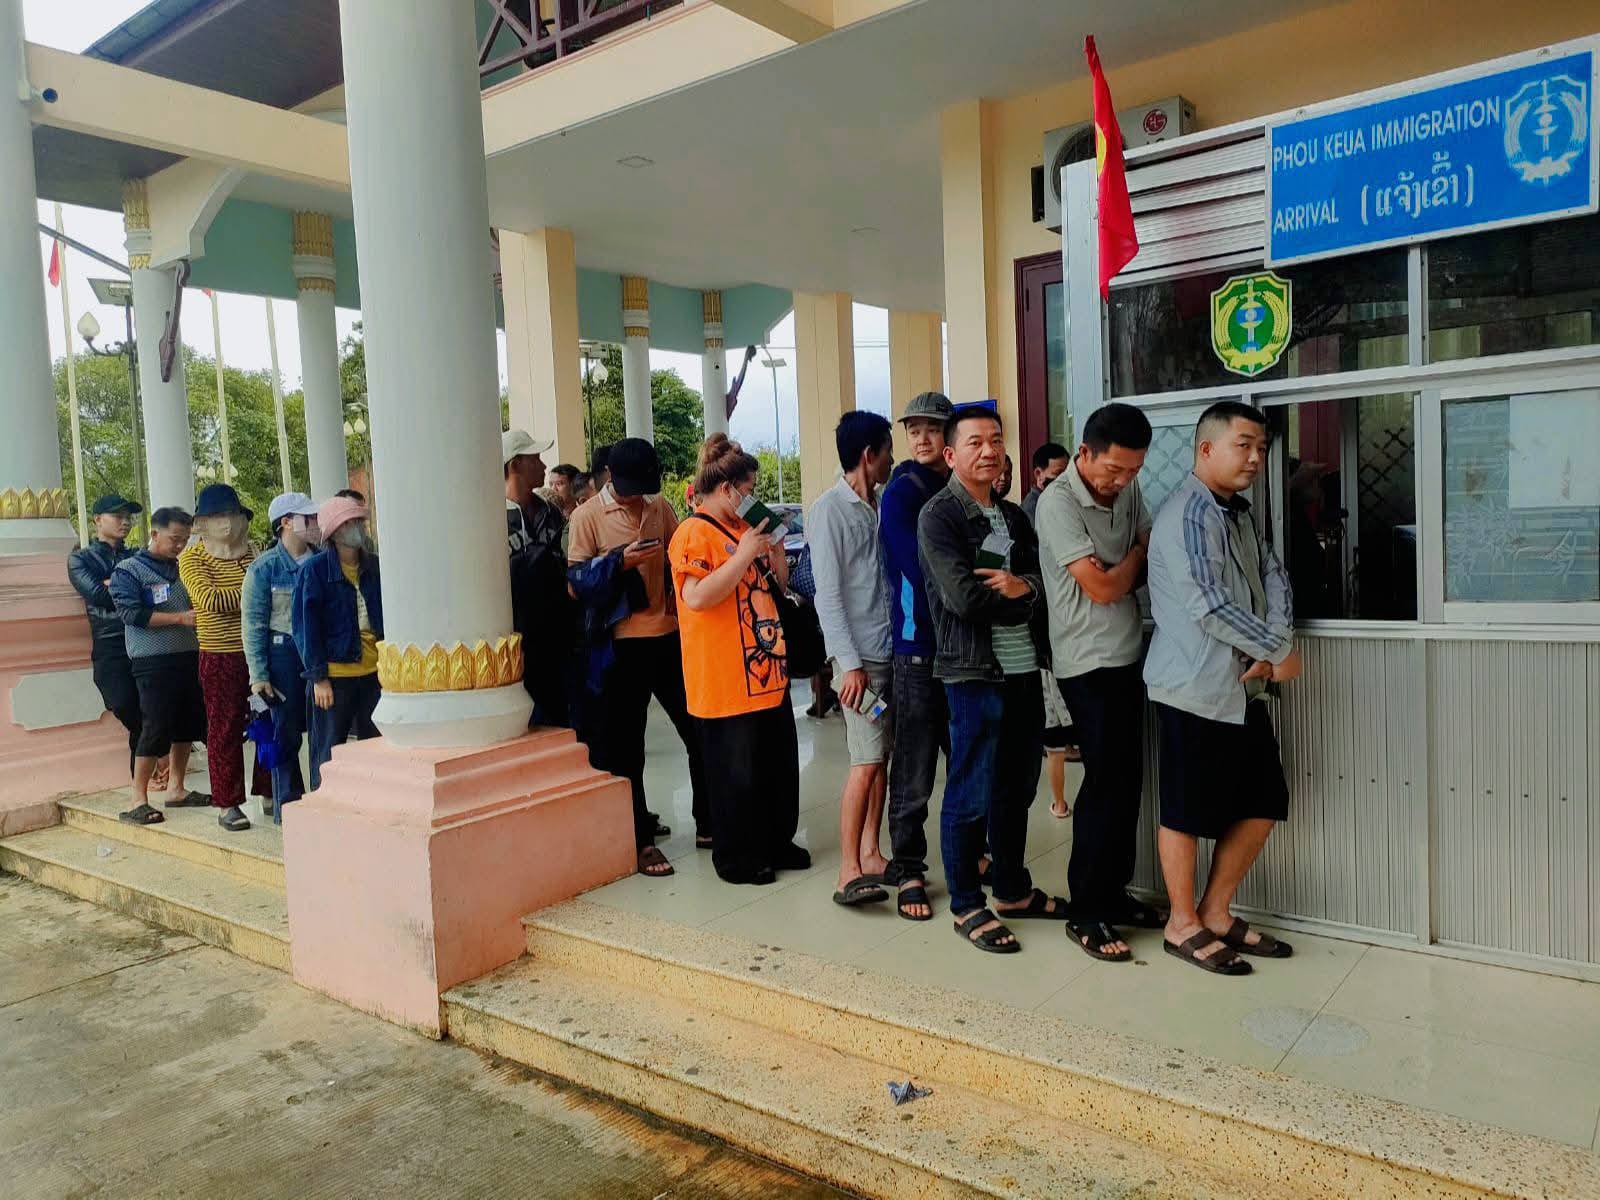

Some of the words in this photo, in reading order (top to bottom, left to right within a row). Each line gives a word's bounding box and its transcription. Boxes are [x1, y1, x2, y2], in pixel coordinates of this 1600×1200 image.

[1273, 138, 1318, 172] PHOU
[1324, 127, 1366, 161] KEUA
[1372, 96, 1501, 151] IMMIGRATION
[1273, 197, 1339, 236] ARRIVAL
